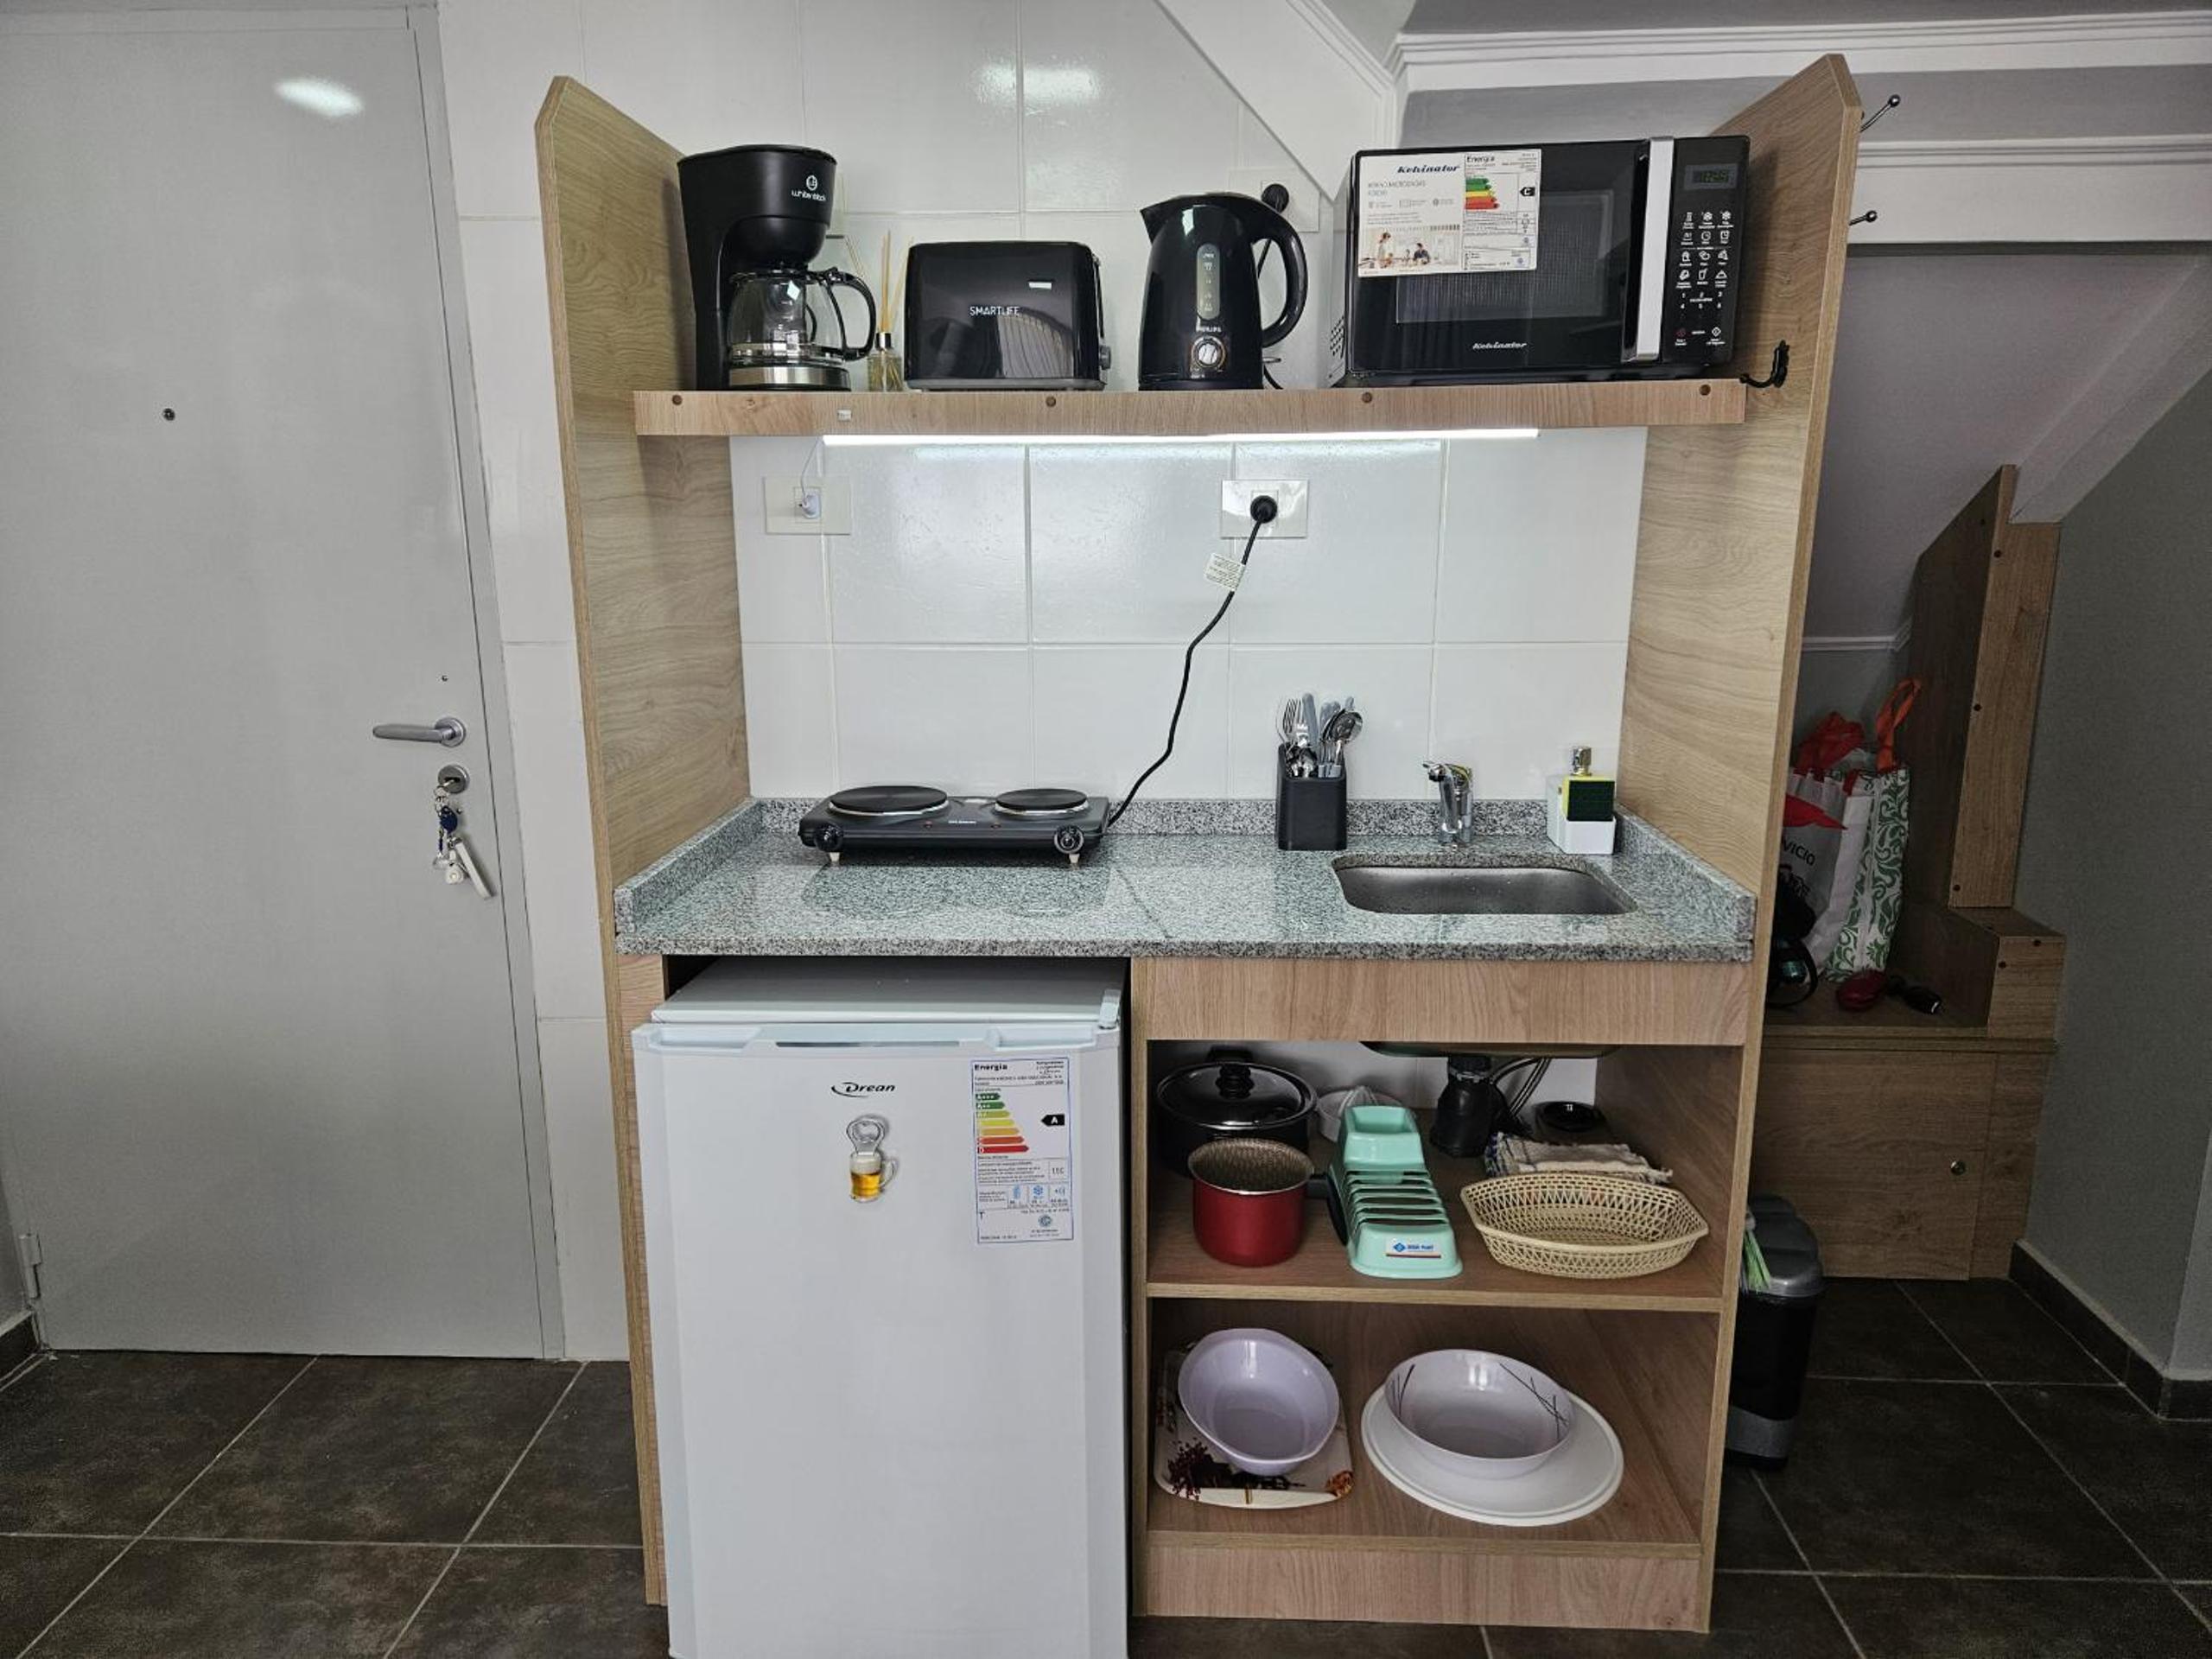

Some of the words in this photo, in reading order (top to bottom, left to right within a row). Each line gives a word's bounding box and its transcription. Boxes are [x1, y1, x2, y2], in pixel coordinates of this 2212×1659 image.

[1397, 164, 1460, 174] Kelvinator
[969, 306, 1020, 316] SMARTLIFE
[1472, 341, 1527, 350] Kelvinator
[841, 1082, 895, 1094] Drean
[1051, 1116, 1058, 1124] A
